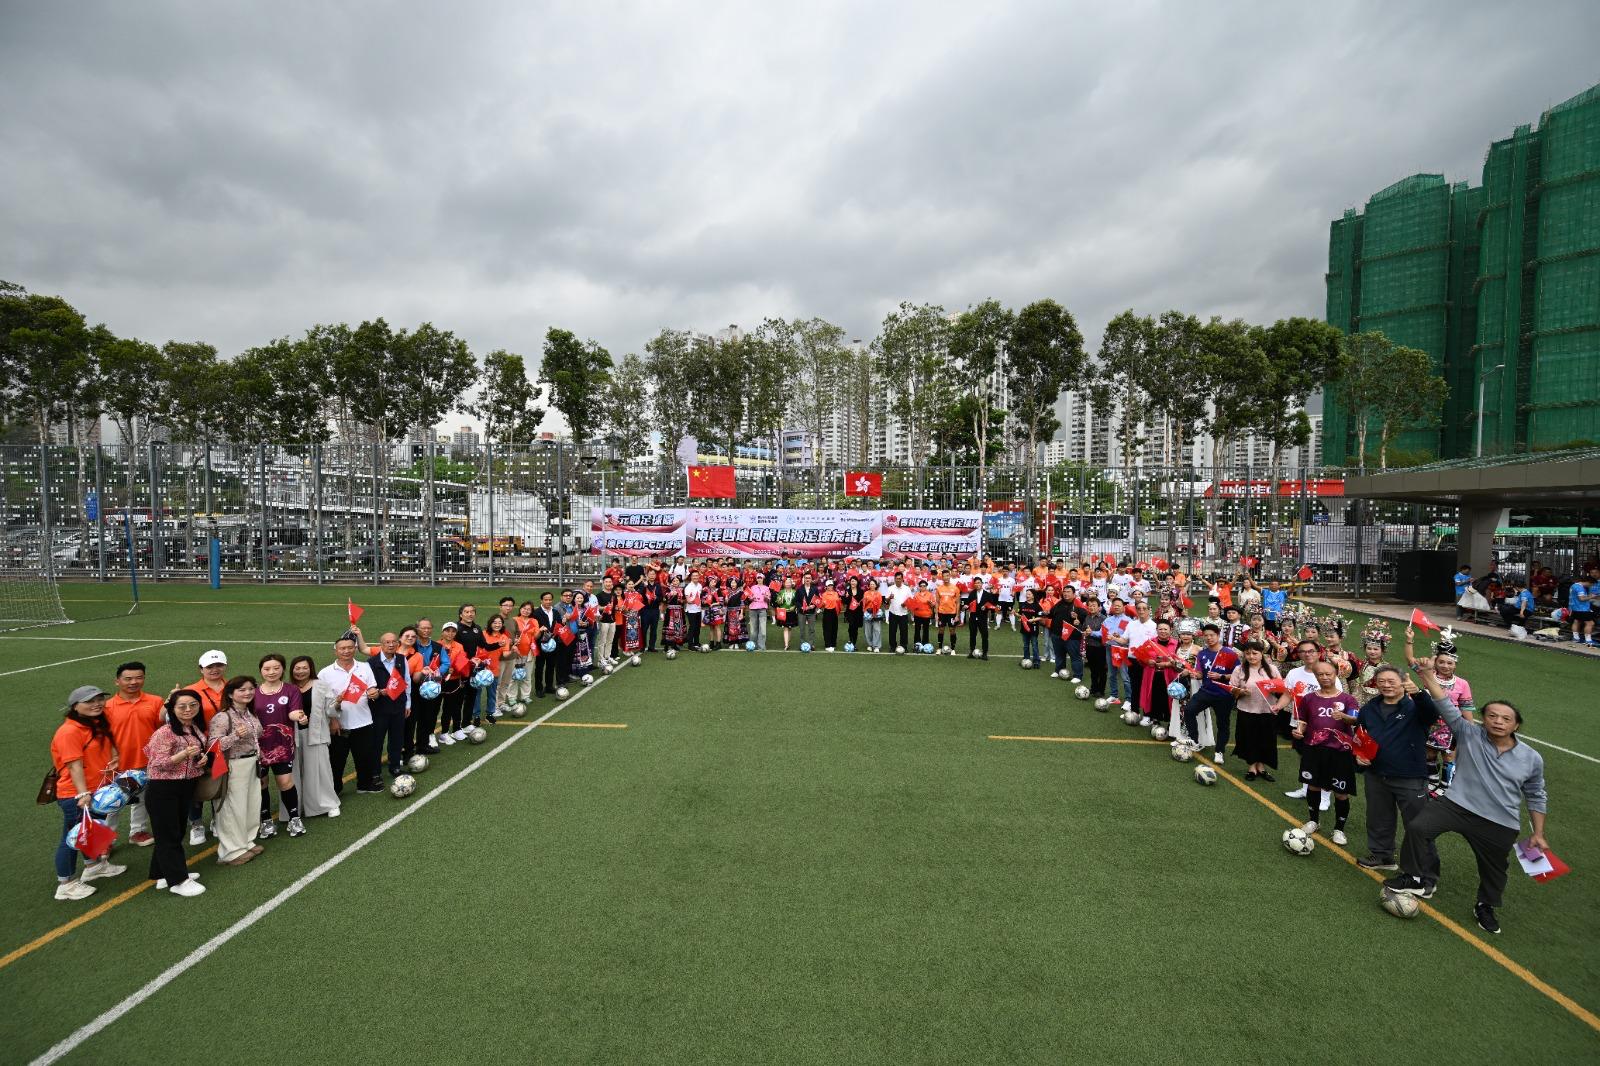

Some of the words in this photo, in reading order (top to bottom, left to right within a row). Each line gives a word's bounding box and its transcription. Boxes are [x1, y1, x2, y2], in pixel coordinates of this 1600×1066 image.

[618, 514, 674, 526] 元朗足球隊
[266, 703, 275, 714] 3
[1318, 707, 1334, 717] 20
[1332, 778, 1346, 790] 20
